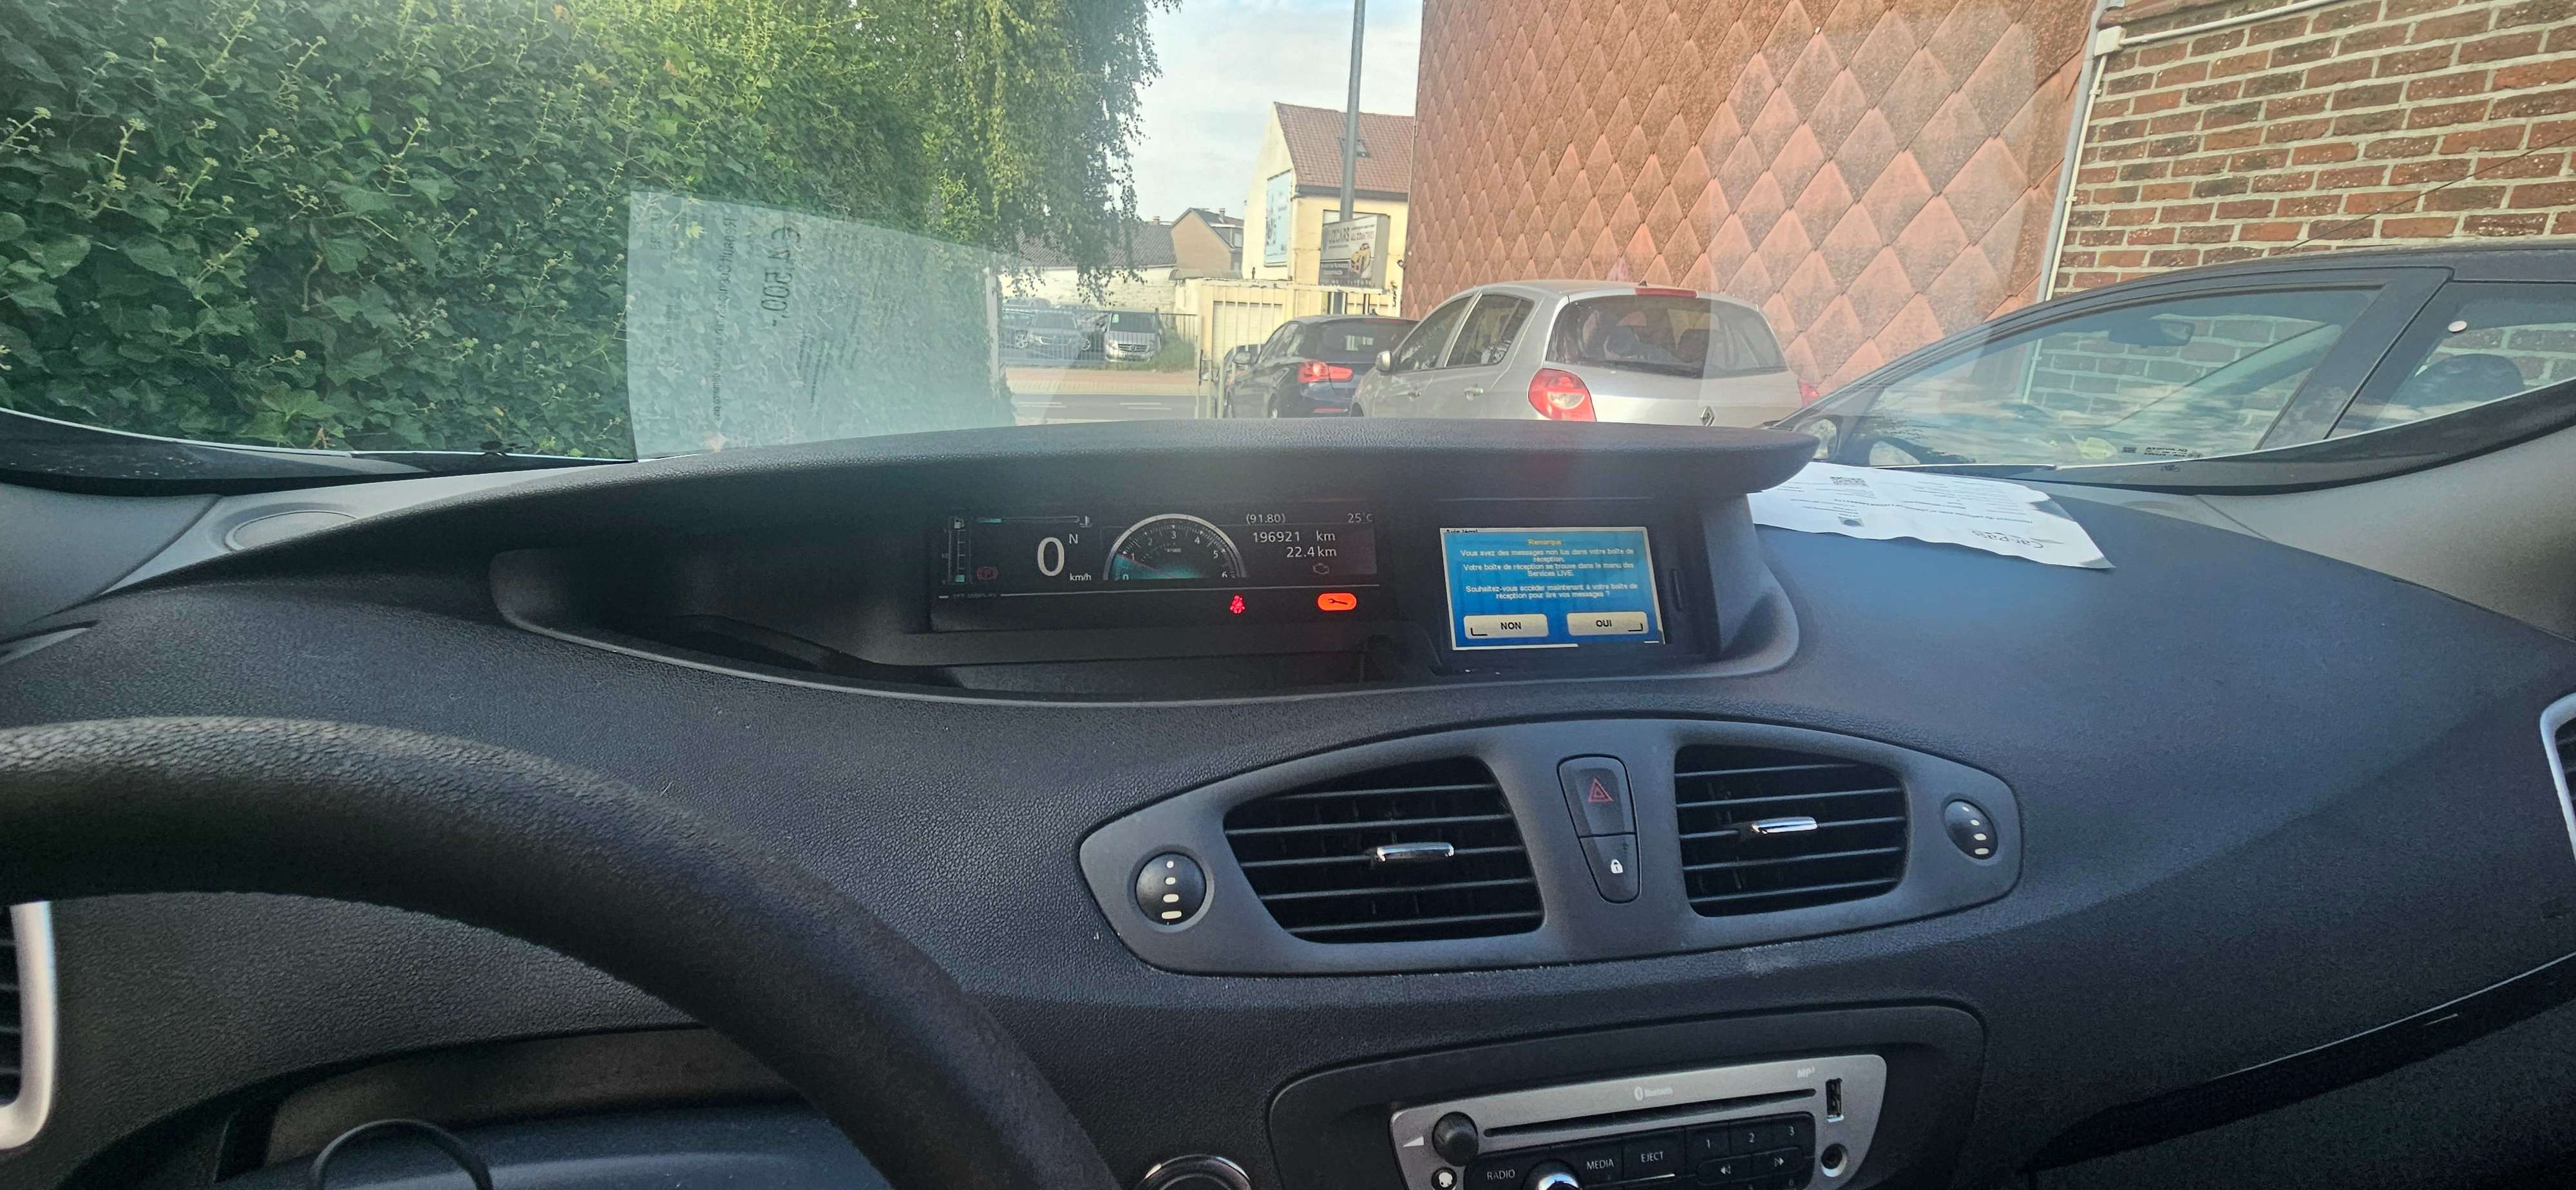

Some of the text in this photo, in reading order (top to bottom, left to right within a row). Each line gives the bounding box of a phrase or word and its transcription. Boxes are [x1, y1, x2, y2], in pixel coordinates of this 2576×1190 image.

[1246, 513, 1286, 524] (91.80)
[1068, 533, 1079, 544] N
[1253, 531, 1336, 543] 196921 km
[1037, 536, 1065, 577] 0
[1287, 545, 1337, 558] 22.4 km
[1070, 573, 1092, 581] km/h
[1501, 621, 1522, 630] NON
[1707, 1126, 1795, 1149] 1 2 3
[1641, 1151, 1664, 1164] EJECT
[1587, 1158, 1615, 1170] MEDIA
[1487, 1169, 1515, 1181] RADIO
